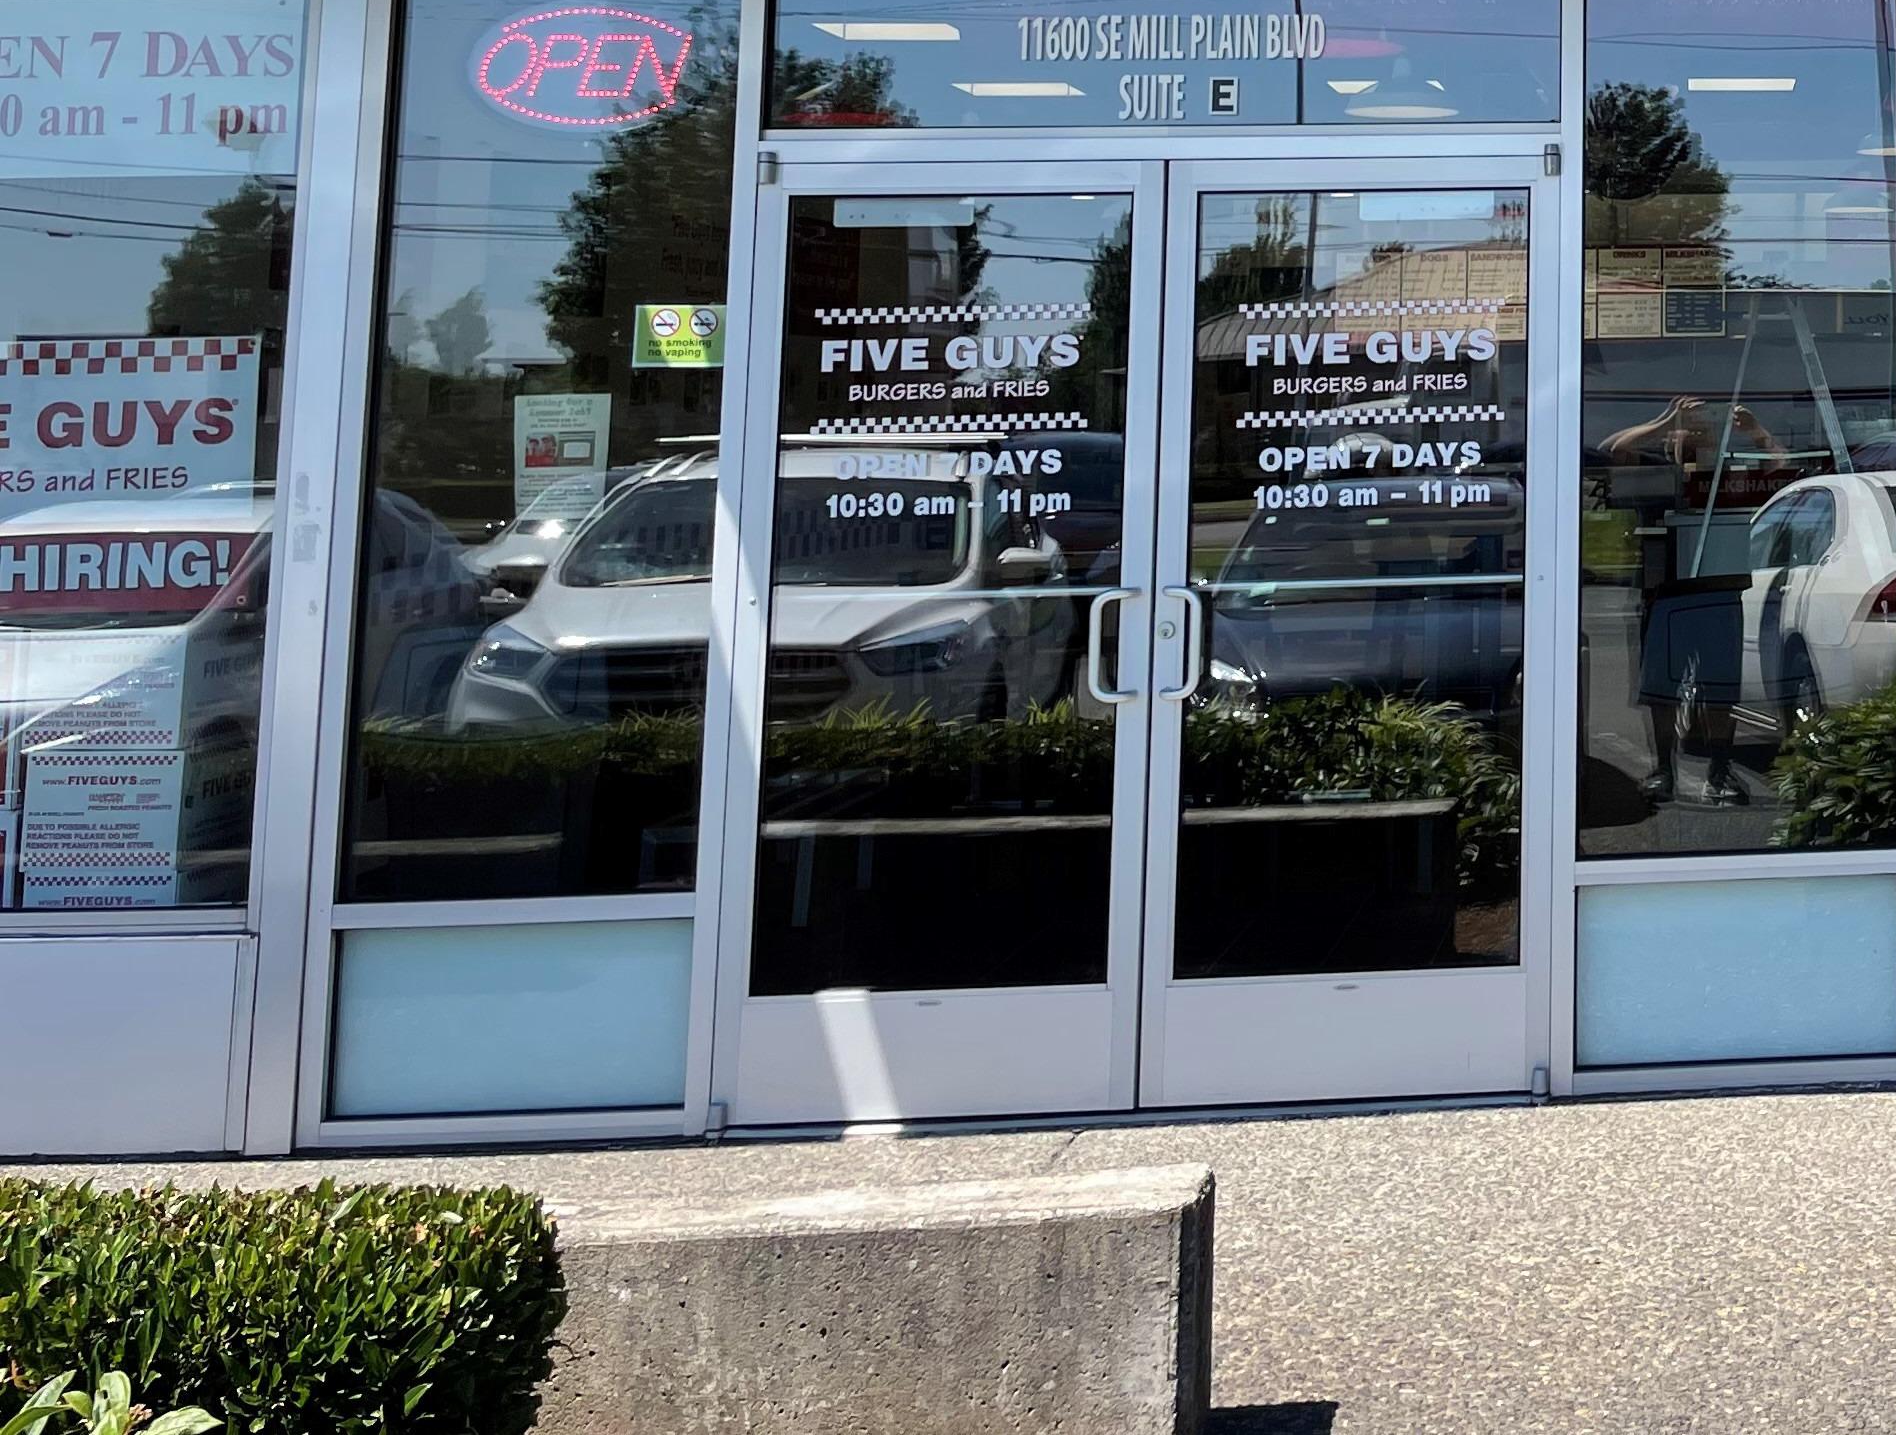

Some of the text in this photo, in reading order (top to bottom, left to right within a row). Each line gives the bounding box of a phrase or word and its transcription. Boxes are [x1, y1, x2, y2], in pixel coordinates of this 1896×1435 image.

[1018, 13, 1326, 61] 11600 SE MILL PLAIN BLVD
[90, 31, 122, 79] 7
[139, 31, 295, 79] DAYS
[478, 32, 693, 98] OPEN
[1119, 74, 1236, 120] SUITE E
[38, 104, 105, 136] am
[155, 92, 198, 135] 11
[217, 103, 287, 148] pm
[648, 338, 712, 349] no smoking
[648, 348, 702, 359] no vaping
[820, 333, 1081, 373] FIVE GUYS
[1245, 327, 1497, 367] FIVE GUYS
[849, 378, 1050, 403] BURGERS and FRIES
[1273, 372, 1468, 396] BURGERS and FRIES
[36, 397, 236, 449] GUYS
[834, 452, 930, 481] OPEN
[968, 448, 1062, 476] DAYS
[1259, 440, 1483, 473] OPEN 7 DAYS
[44, 468, 95, 492] and
[106, 466, 188, 491] FRIES
[1254, 484, 1329, 509] 10:30
[1338, 486, 1379, 507] am
[1418, 481, 1443, 504] 11
[1450, 482, 1490, 508] pm
[826, 493, 905, 519] 10:30
[914, 495, 955, 517] am
[996, 488, 1023, 513] 11
[1029, 490, 1071, 517] pm
